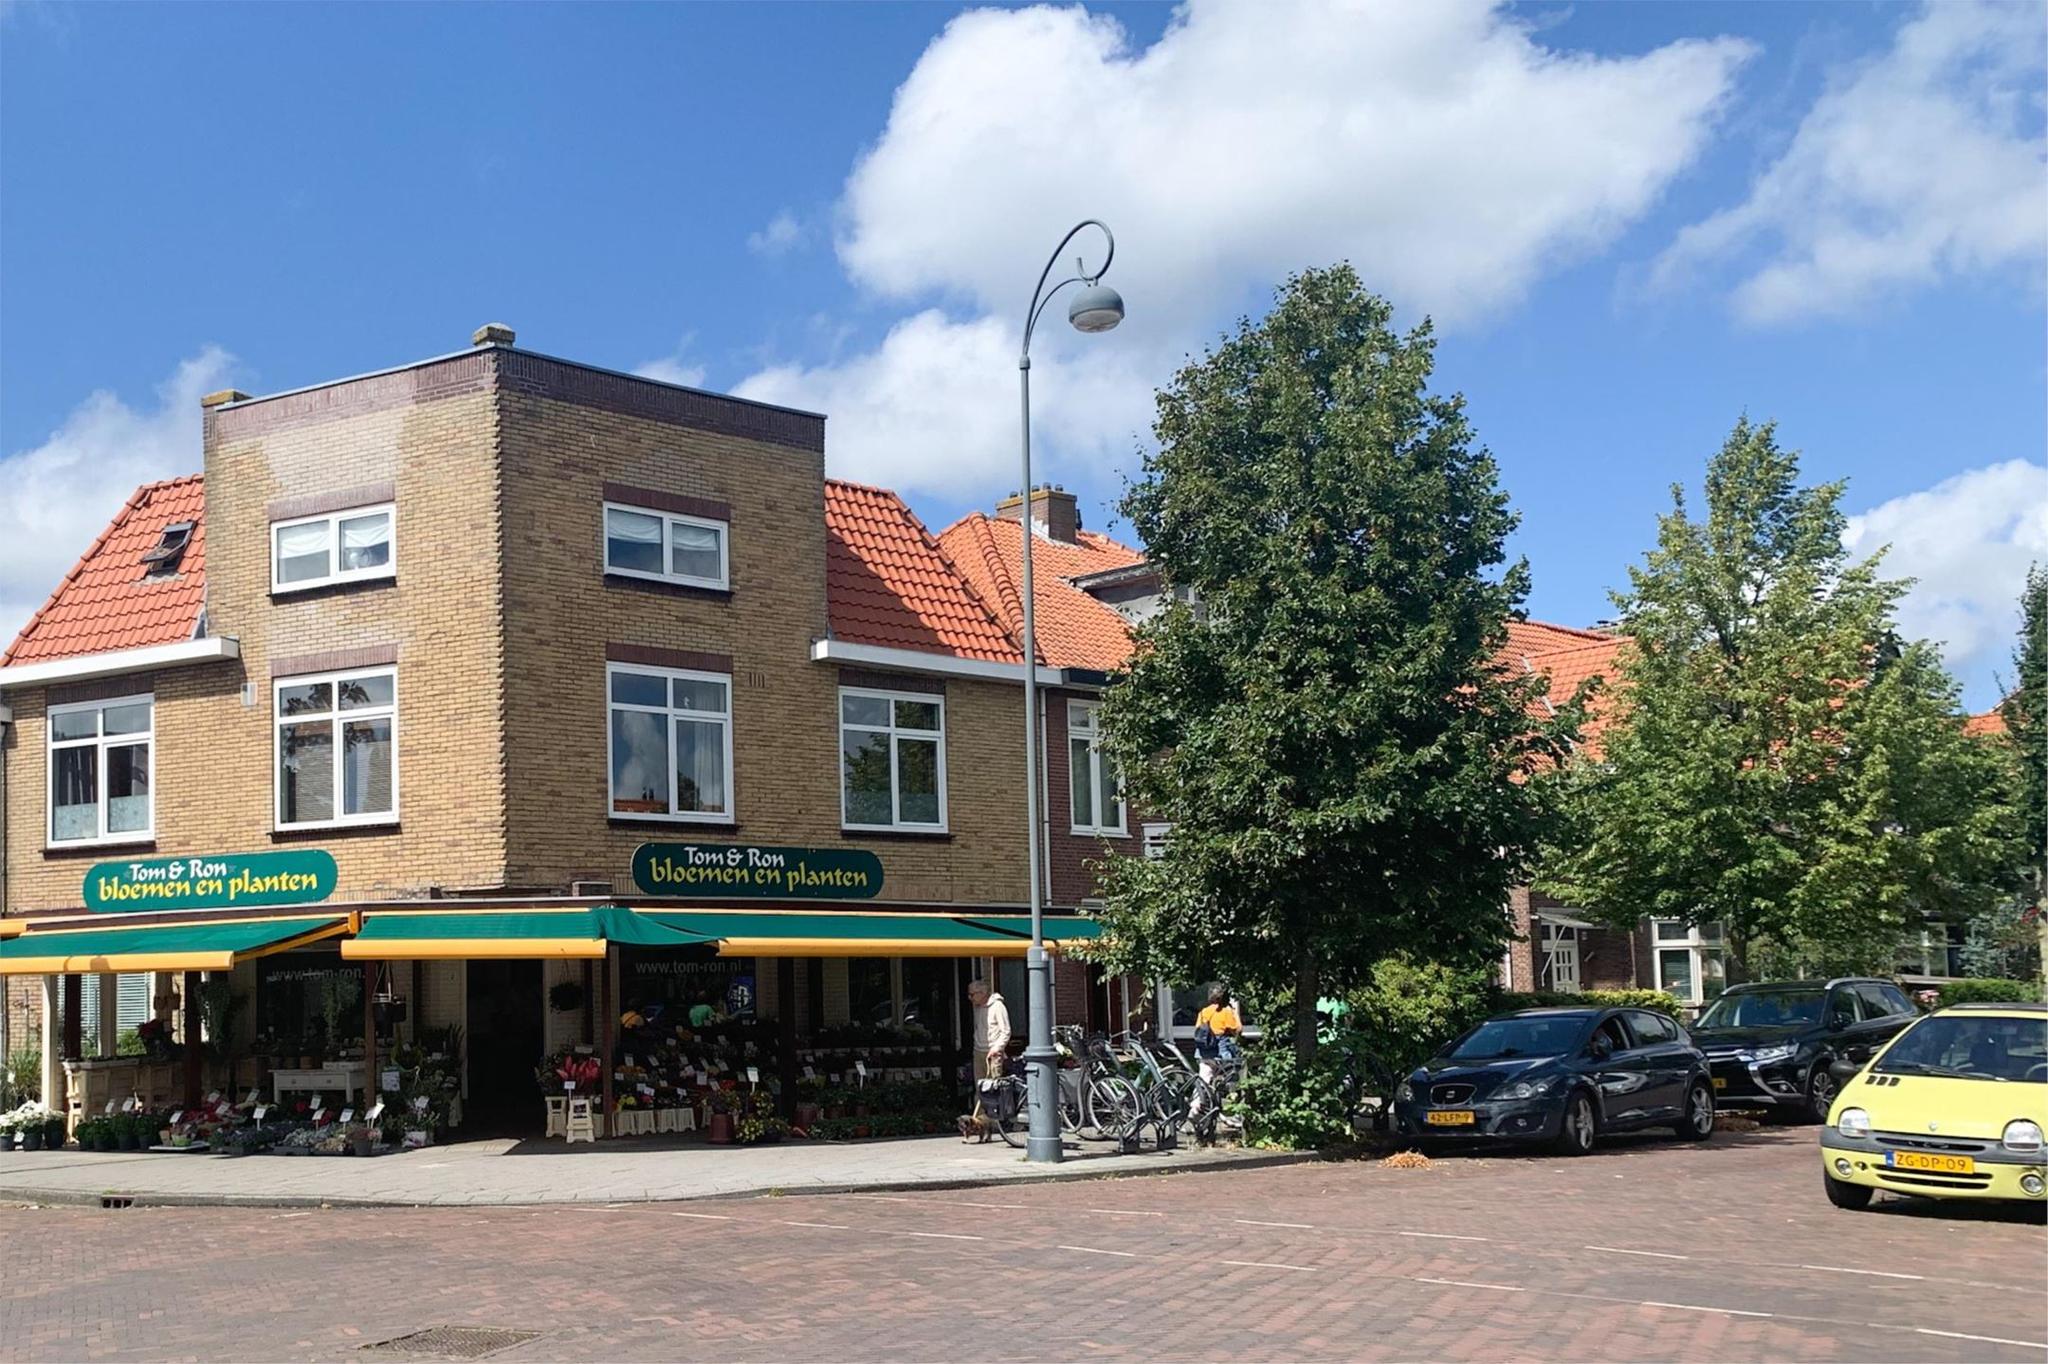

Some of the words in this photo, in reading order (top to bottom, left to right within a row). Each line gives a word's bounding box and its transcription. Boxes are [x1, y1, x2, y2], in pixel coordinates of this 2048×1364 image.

[683, 846, 724, 865] Tom
[726, 848, 744, 867] &
[747, 848, 785, 868] Ron
[129, 863, 167, 881] Tom
[169, 861, 186, 880] &
[188, 859, 228, 878] Ron
[649, 856, 750, 885] bloemen
[754, 868, 782, 884] en
[786, 862, 868, 892] planten
[98, 876, 191, 901] bloemen
[195, 879, 223, 897] en
[228, 868, 318, 900] planten
[635, 959, 742, 973] www.tom-ron.nl
[1896, 1153, 1966, 1170] ZG-DP-09
